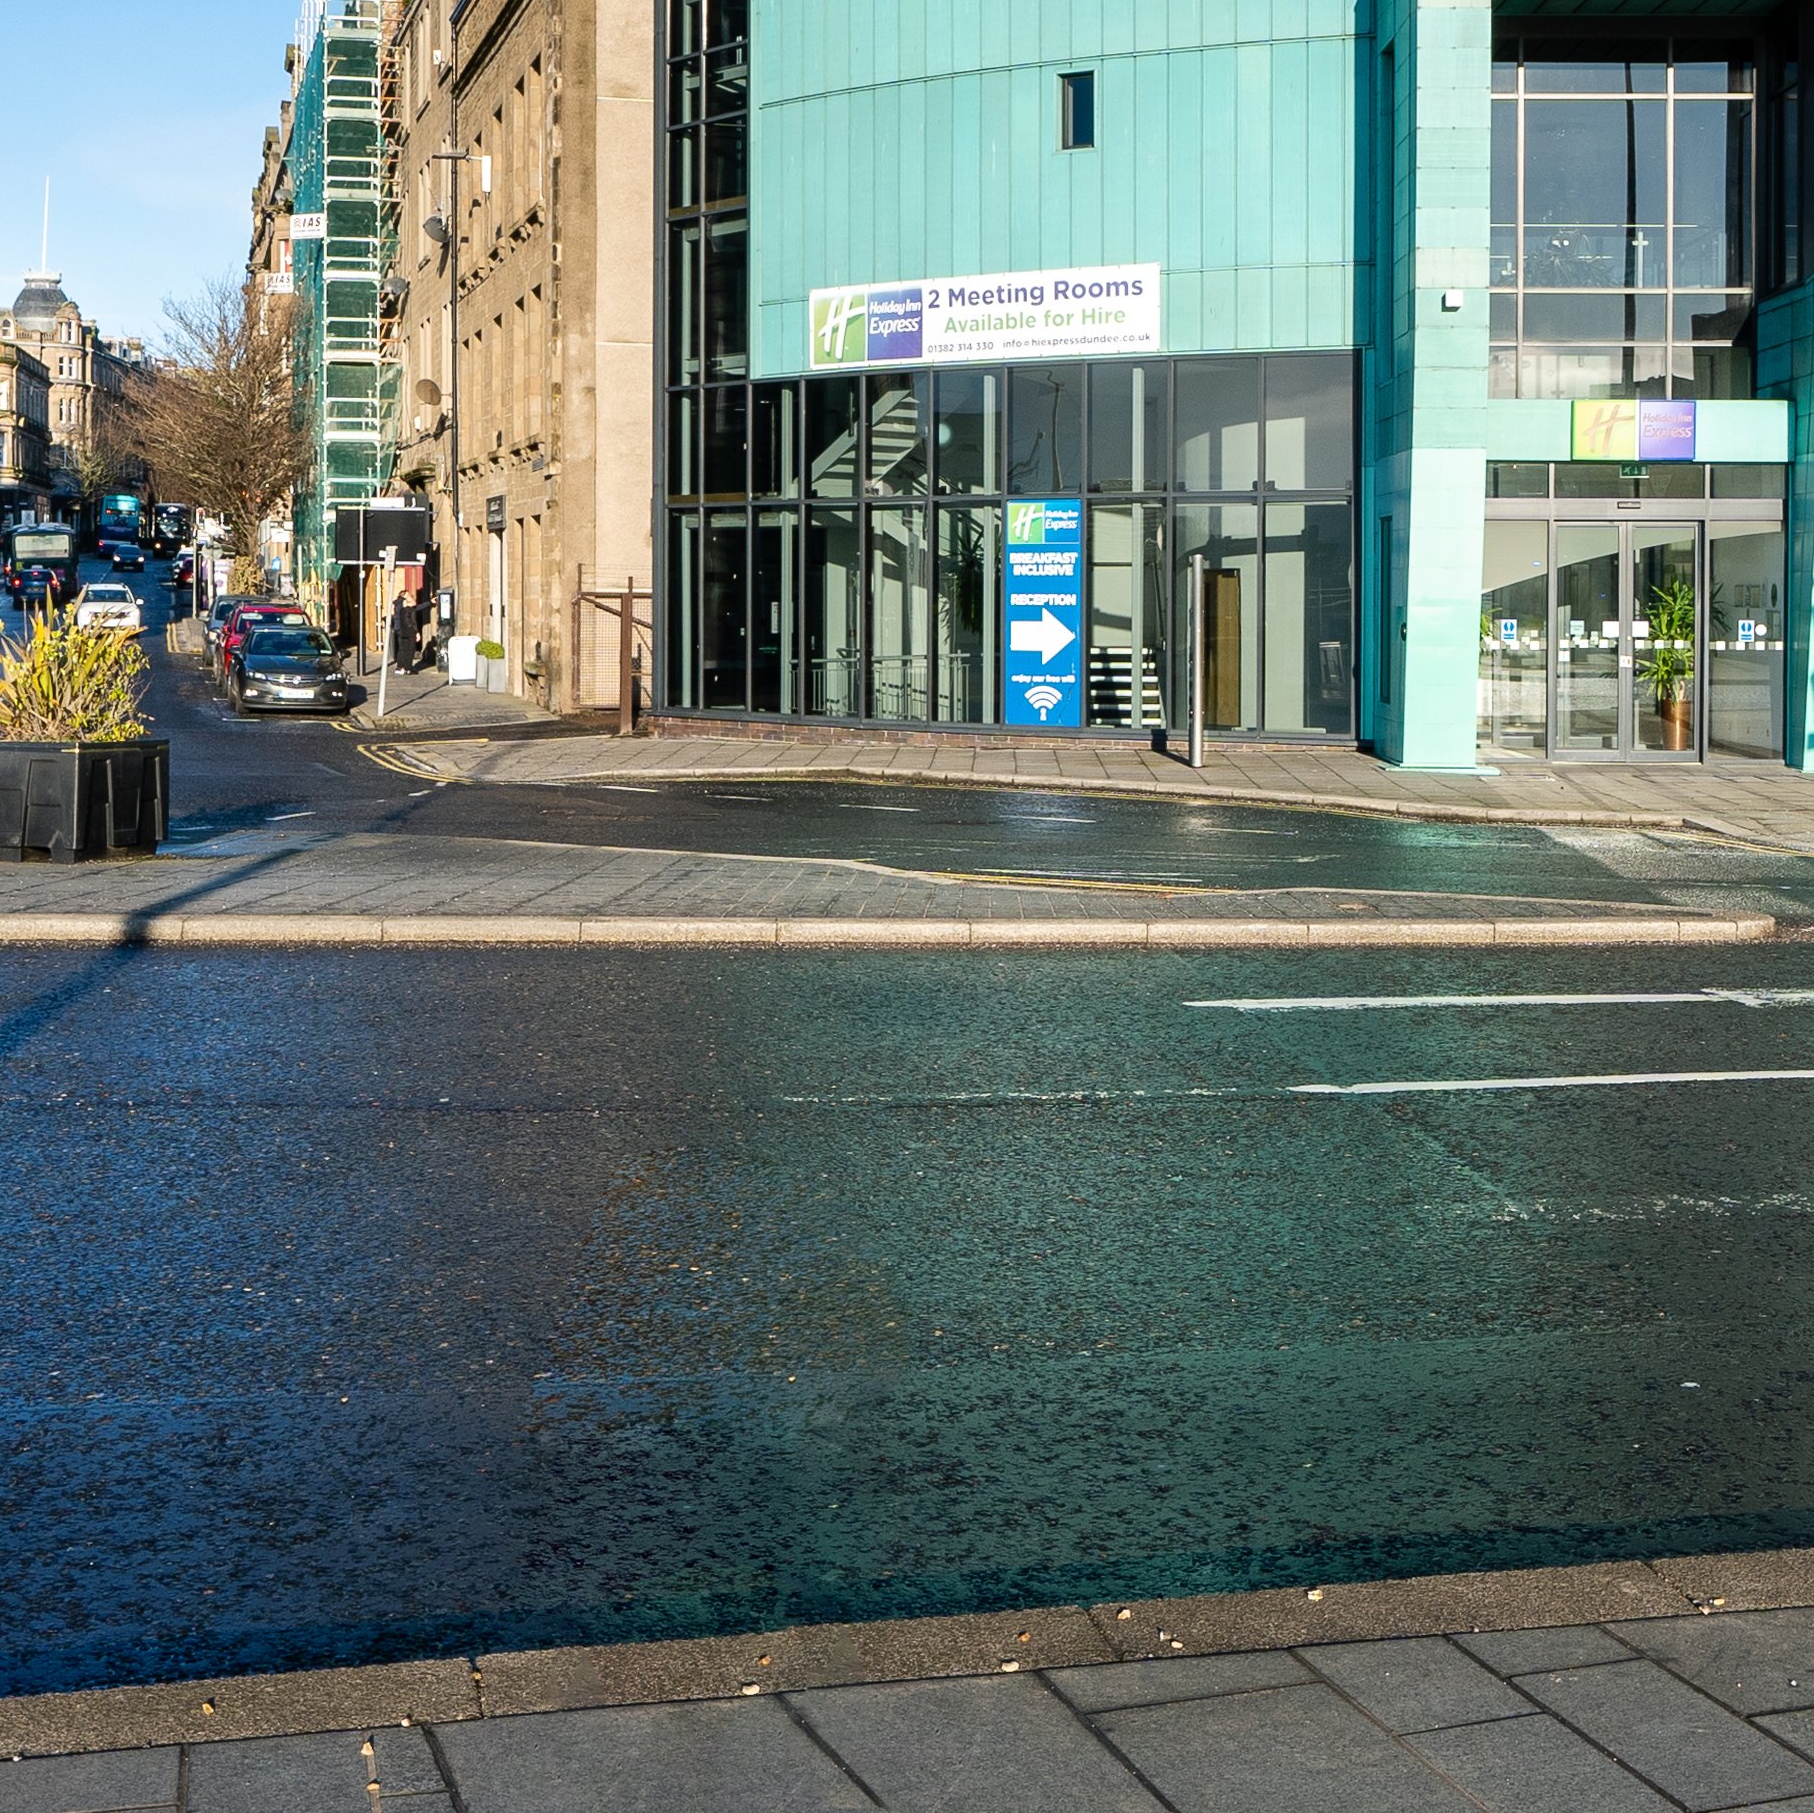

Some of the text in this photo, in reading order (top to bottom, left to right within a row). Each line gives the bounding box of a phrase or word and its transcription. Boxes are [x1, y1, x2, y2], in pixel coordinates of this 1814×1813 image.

[928, 279, 1144, 309] 2 Meeting Rooms
[869, 299, 922, 316] Holiday Inn
[944, 306, 1126, 333] Available for Hire
[869, 316, 921, 337] Express
[927, 343, 954, 353] 01382
[957, 342, 973, 352] 314
[975, 341, 994, 350] 330
[1643, 412, 1693, 425] Holiday Inn
[1643, 424, 1693, 441] Express
[1045, 518, 1078, 531] Express
[1009, 552, 1078, 564] BREAKFAST
[1013, 564, 1074, 576] INCLUSIVE
[1010, 593, 1077, 606] RECEPTION
